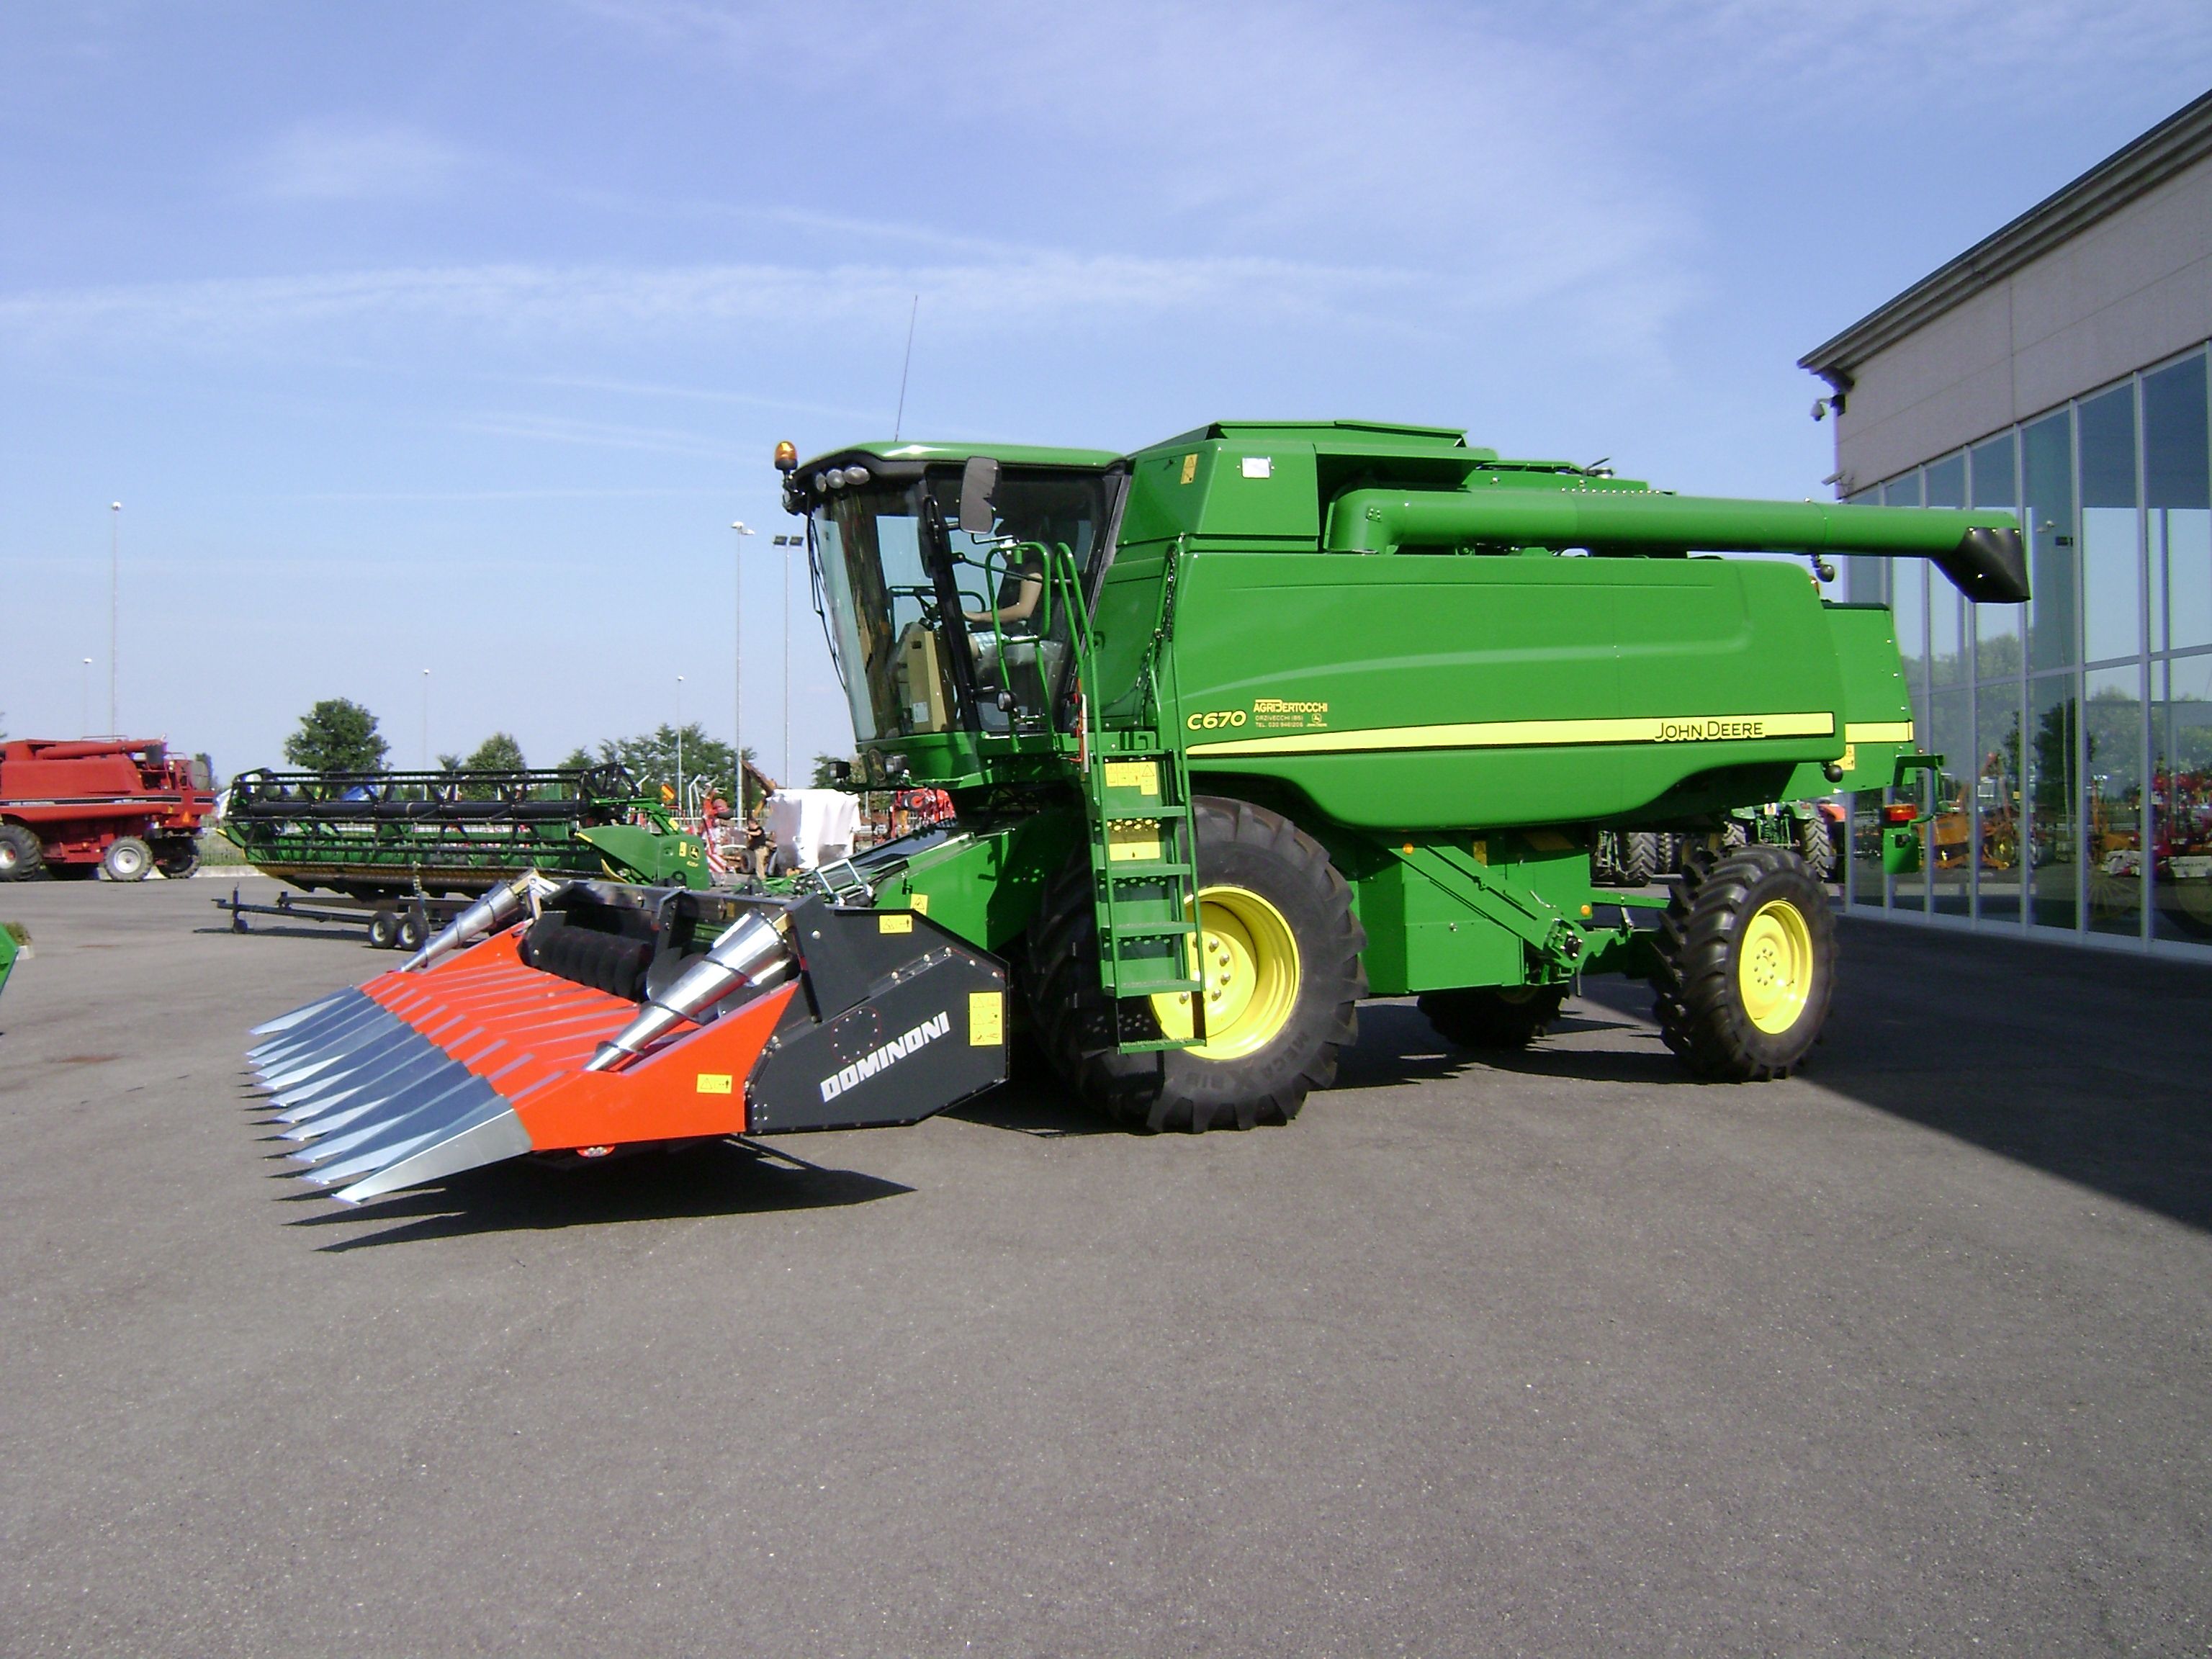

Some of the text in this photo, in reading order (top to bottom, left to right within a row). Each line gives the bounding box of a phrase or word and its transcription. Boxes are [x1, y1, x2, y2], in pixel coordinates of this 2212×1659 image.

[1254, 699, 1328, 713] AGRIBERTOCCHI
[1187, 710, 1246, 730] C670
[1655, 721, 1763, 739] JOHN DEERE
[819, 1011, 950, 1103] DOMINONI
